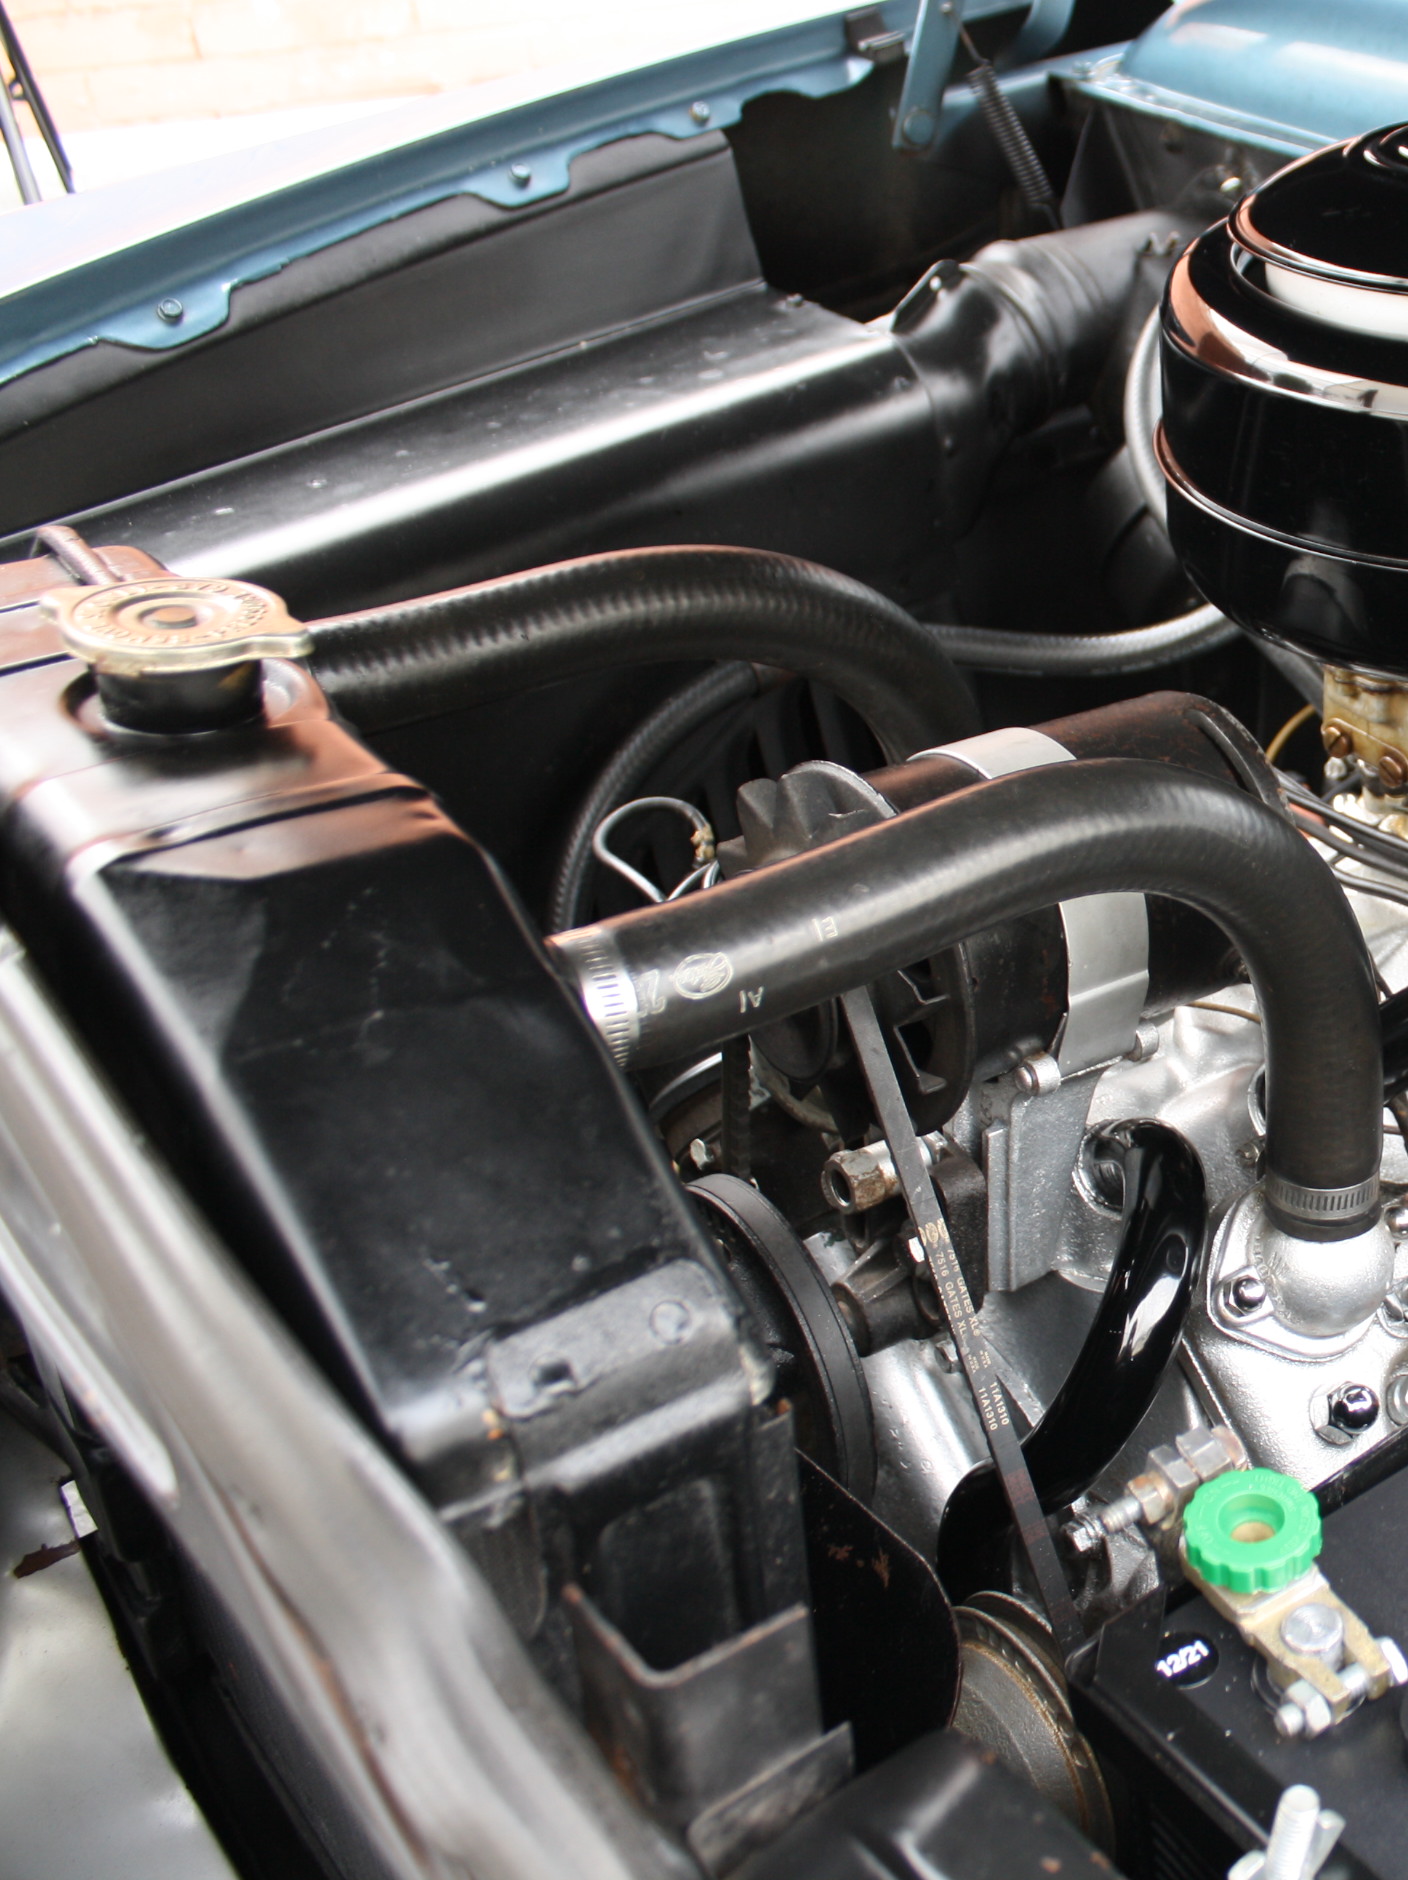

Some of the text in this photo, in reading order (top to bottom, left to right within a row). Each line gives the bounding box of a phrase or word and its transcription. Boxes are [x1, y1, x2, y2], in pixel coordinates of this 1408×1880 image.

[933, 1251, 951, 1277] 7516
[941, 1281, 964, 1318] GATES
[953, 1276, 976, 1313] GATES
[977, 1386, 998, 1431] 11A1310
[988, 1381, 1010, 1425] 11A1310
[1155, 1640, 1209, 1677] 12/21
